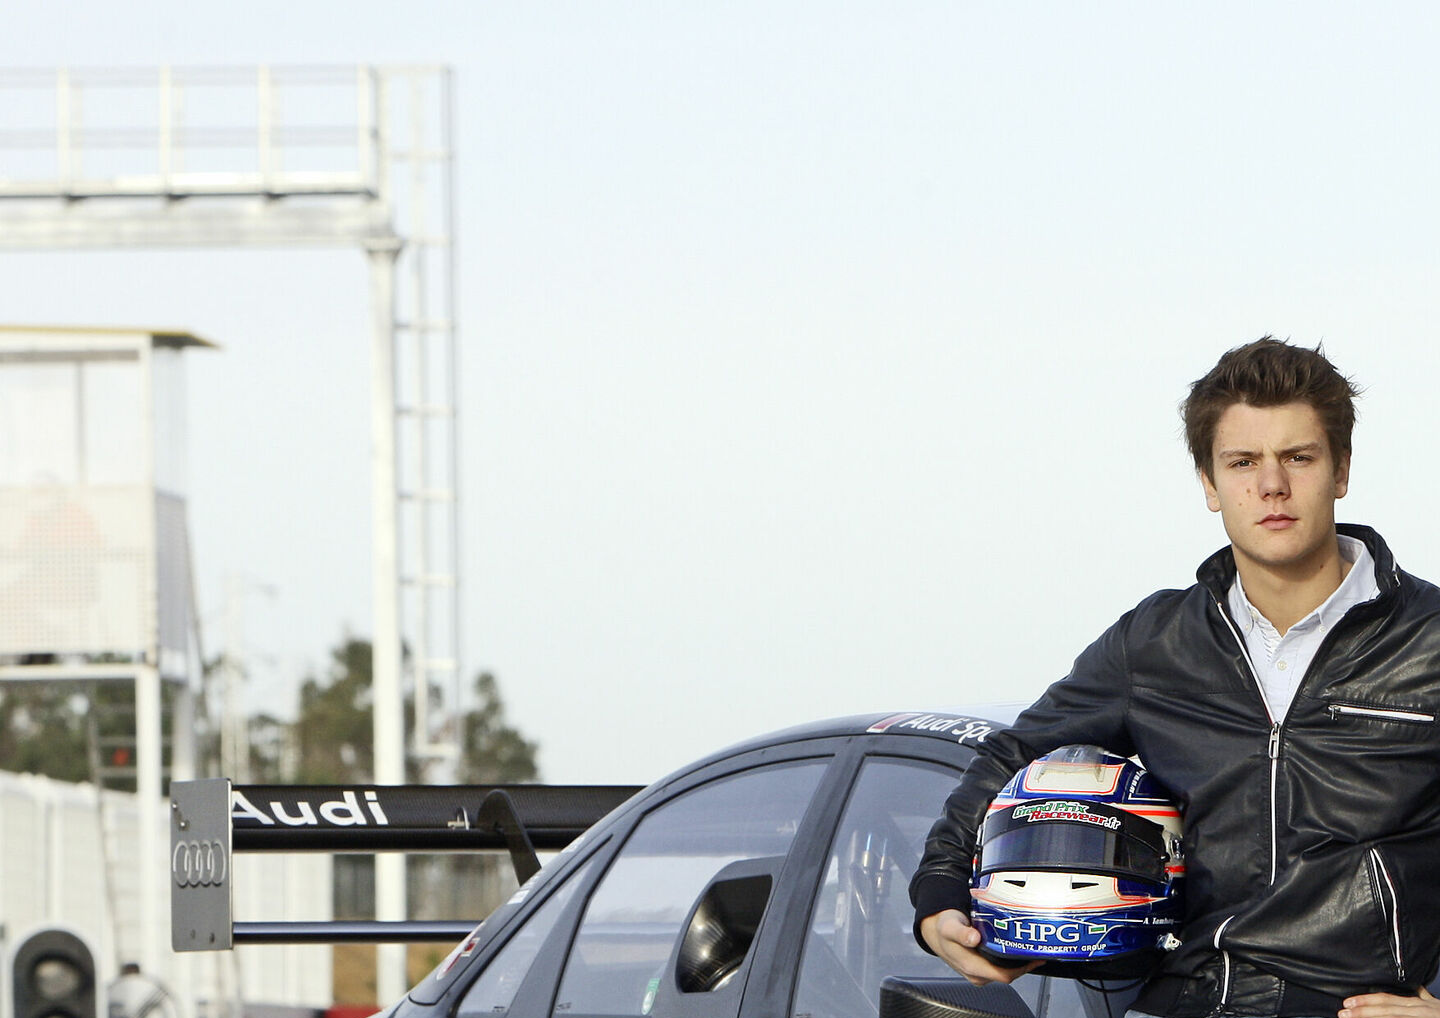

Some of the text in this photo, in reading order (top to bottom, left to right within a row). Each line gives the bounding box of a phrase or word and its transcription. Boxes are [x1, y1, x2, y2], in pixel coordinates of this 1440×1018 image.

[900, 714, 969, 733] Audi
[232, 791, 389, 826] Audi
[1012, 801, 1090, 819] Grand Prix
[1014, 921, 1080, 943] HPG
[1038, 945, 1078, 953] PROPERTY
[1081, 943, 1107, 952] GROUP
